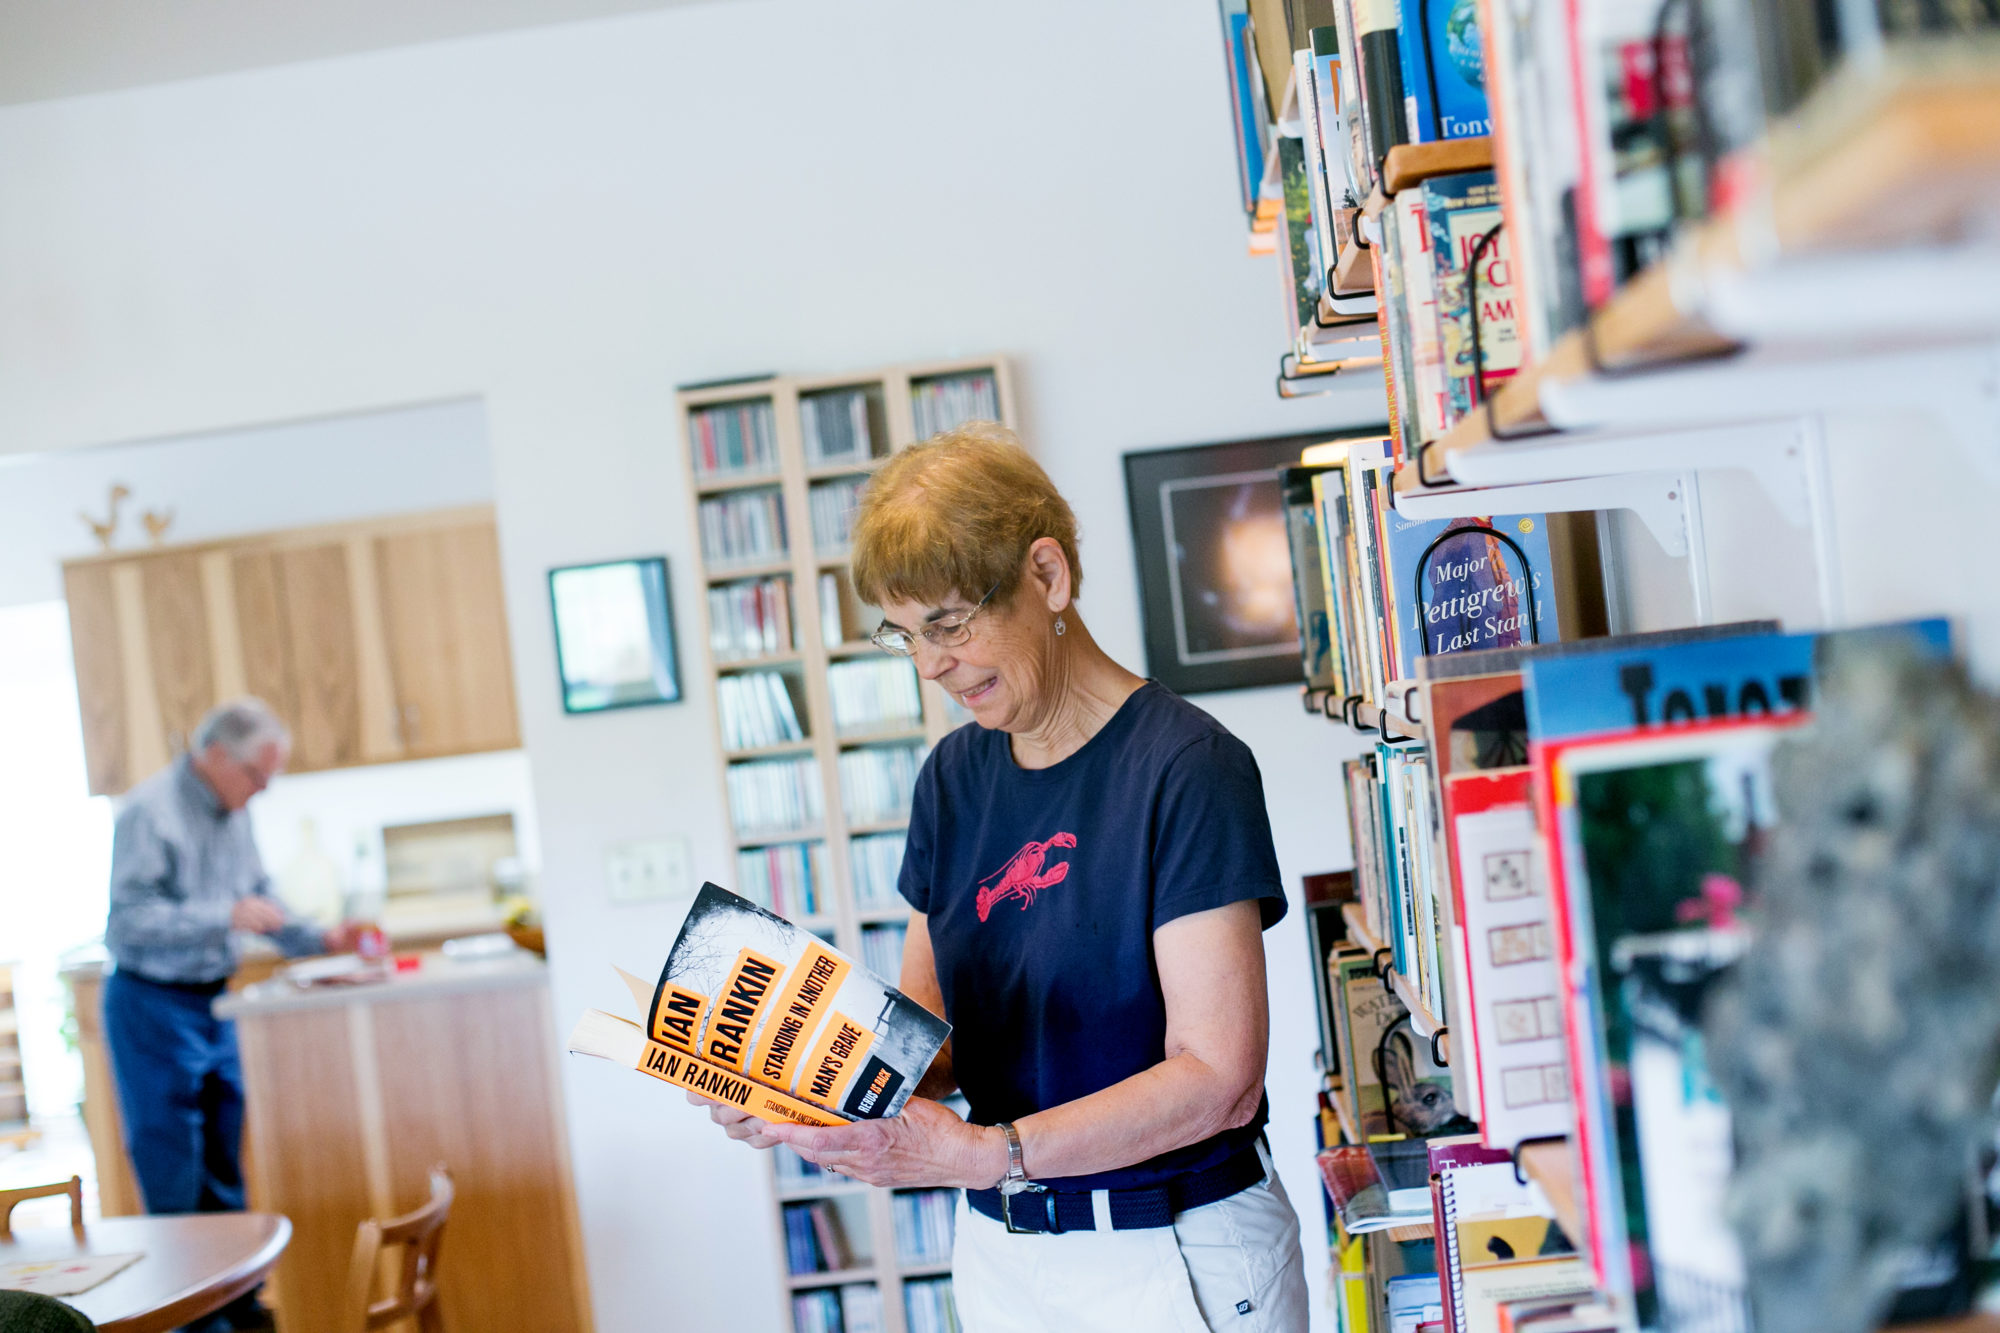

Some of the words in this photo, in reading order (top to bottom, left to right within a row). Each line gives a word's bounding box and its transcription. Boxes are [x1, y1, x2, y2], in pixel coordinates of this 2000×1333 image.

[1435, 555, 1488, 585] Major
[1436, 628, 1480, 656] Last
[797, 954, 838, 1007] ANOTHER
[661, 990, 701, 1046] IAN
[709, 956, 776, 1065] RANKIN
[788, 1001, 811, 1019] IN
[762, 1016, 804, 1081] STANDING
[810, 1056, 843, 1098] MAN'S
[829, 1022, 863, 1060] GRAVE
[646, 1047, 682, 1078] IAN
[682, 1061, 753, 1106] RANKIN
[869, 1081, 883, 1096] IS
[874, 1067, 892, 1088] BACK
[763, 1099, 791, 1118] STANDING
[789, 1109, 798, 1120] IN
[857, 1089, 879, 1114] REBUS
